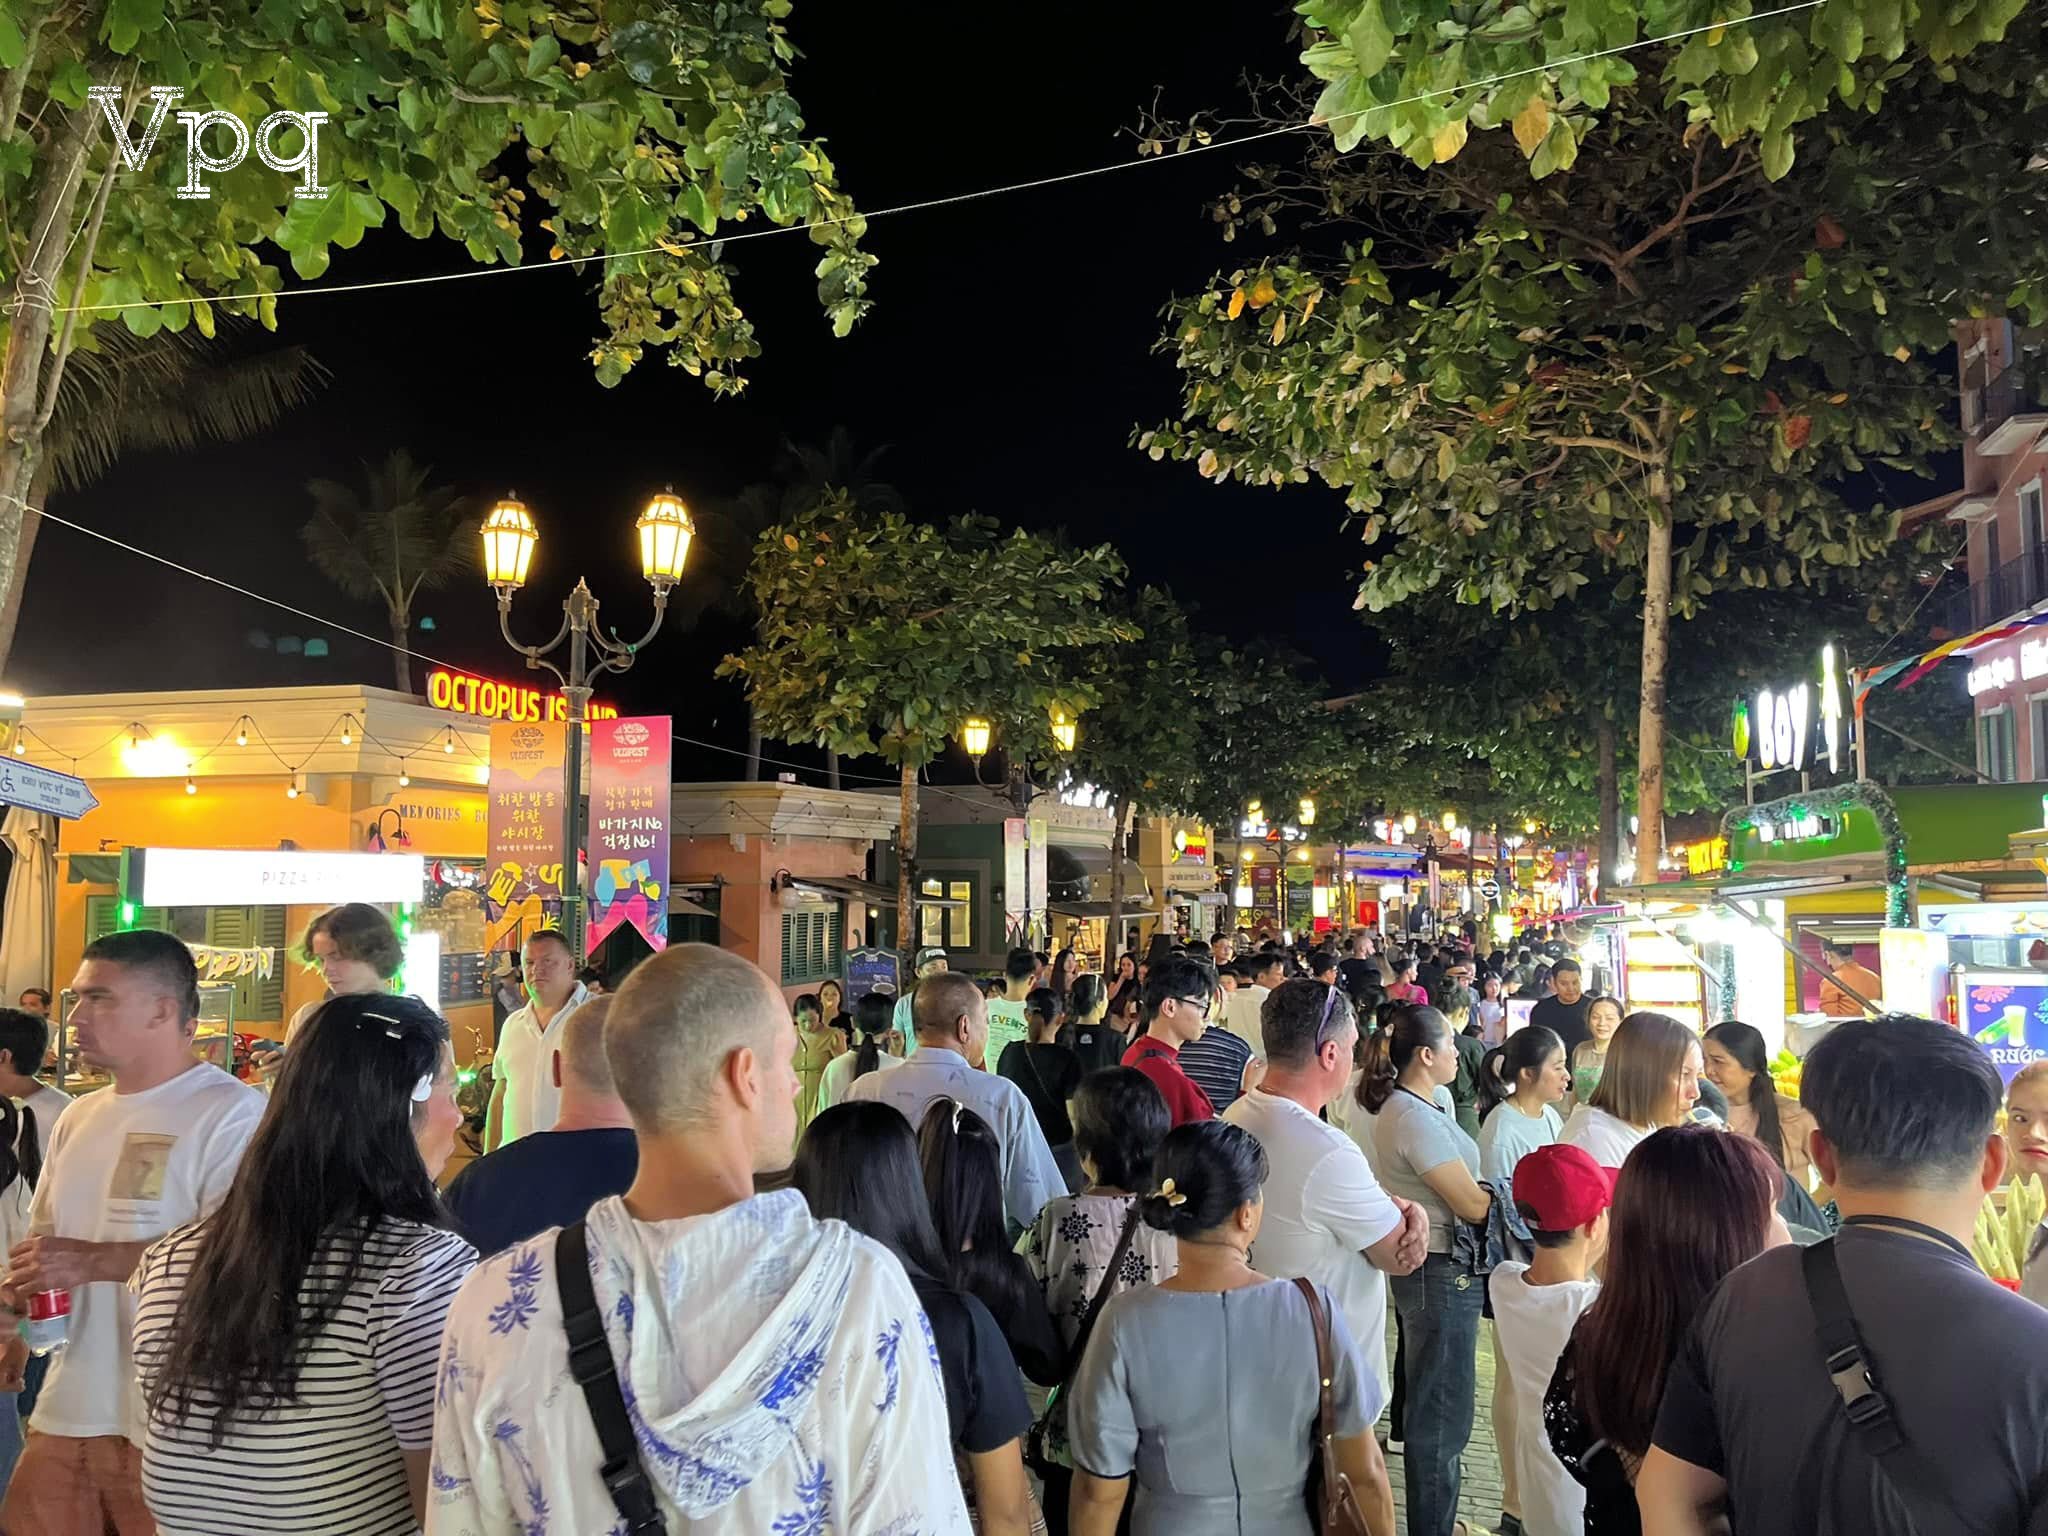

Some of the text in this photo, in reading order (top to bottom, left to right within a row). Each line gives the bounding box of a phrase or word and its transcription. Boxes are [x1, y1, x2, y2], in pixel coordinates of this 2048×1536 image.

[430, 671, 540, 723] OCTOPUS
[1758, 683, 1808, 771] BOY
[399, 804, 461, 822] MEMORIES
[599, 816, 643, 831] 바가지
[501, 825, 545, 841] 야시장
[602, 833, 631, 851] 걱정
[262, 871, 307, 885] PIZZA
